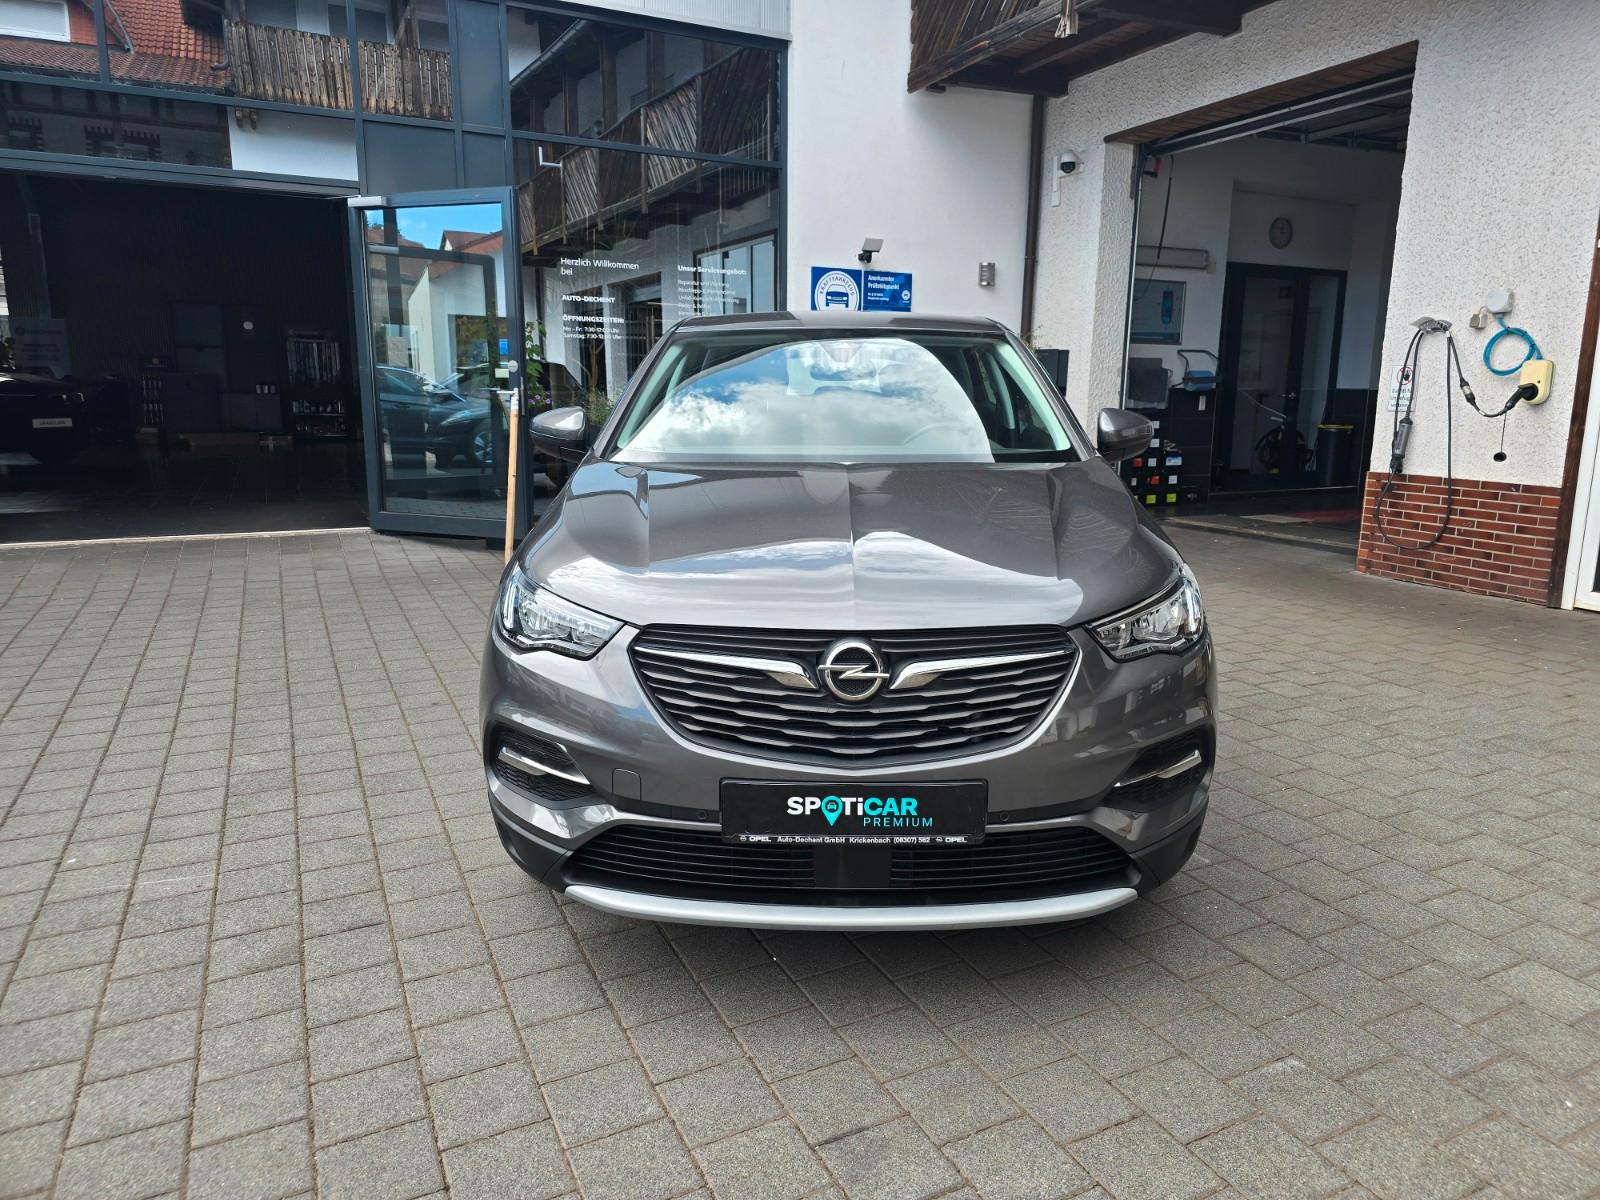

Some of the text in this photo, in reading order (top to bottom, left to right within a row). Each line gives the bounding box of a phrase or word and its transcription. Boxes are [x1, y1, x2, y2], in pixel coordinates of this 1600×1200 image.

[560, 257, 640, 270] Herzlich Willkommen
[560, 267, 573, 276] bei
[820, 274, 856, 296] KRAFTFAHRZEUG
[561, 294, 616, 304] AUTO-DECHENT
[863, 817, 933, 827] PREMIUM
[849, 836, 891, 844] Krickenbach
